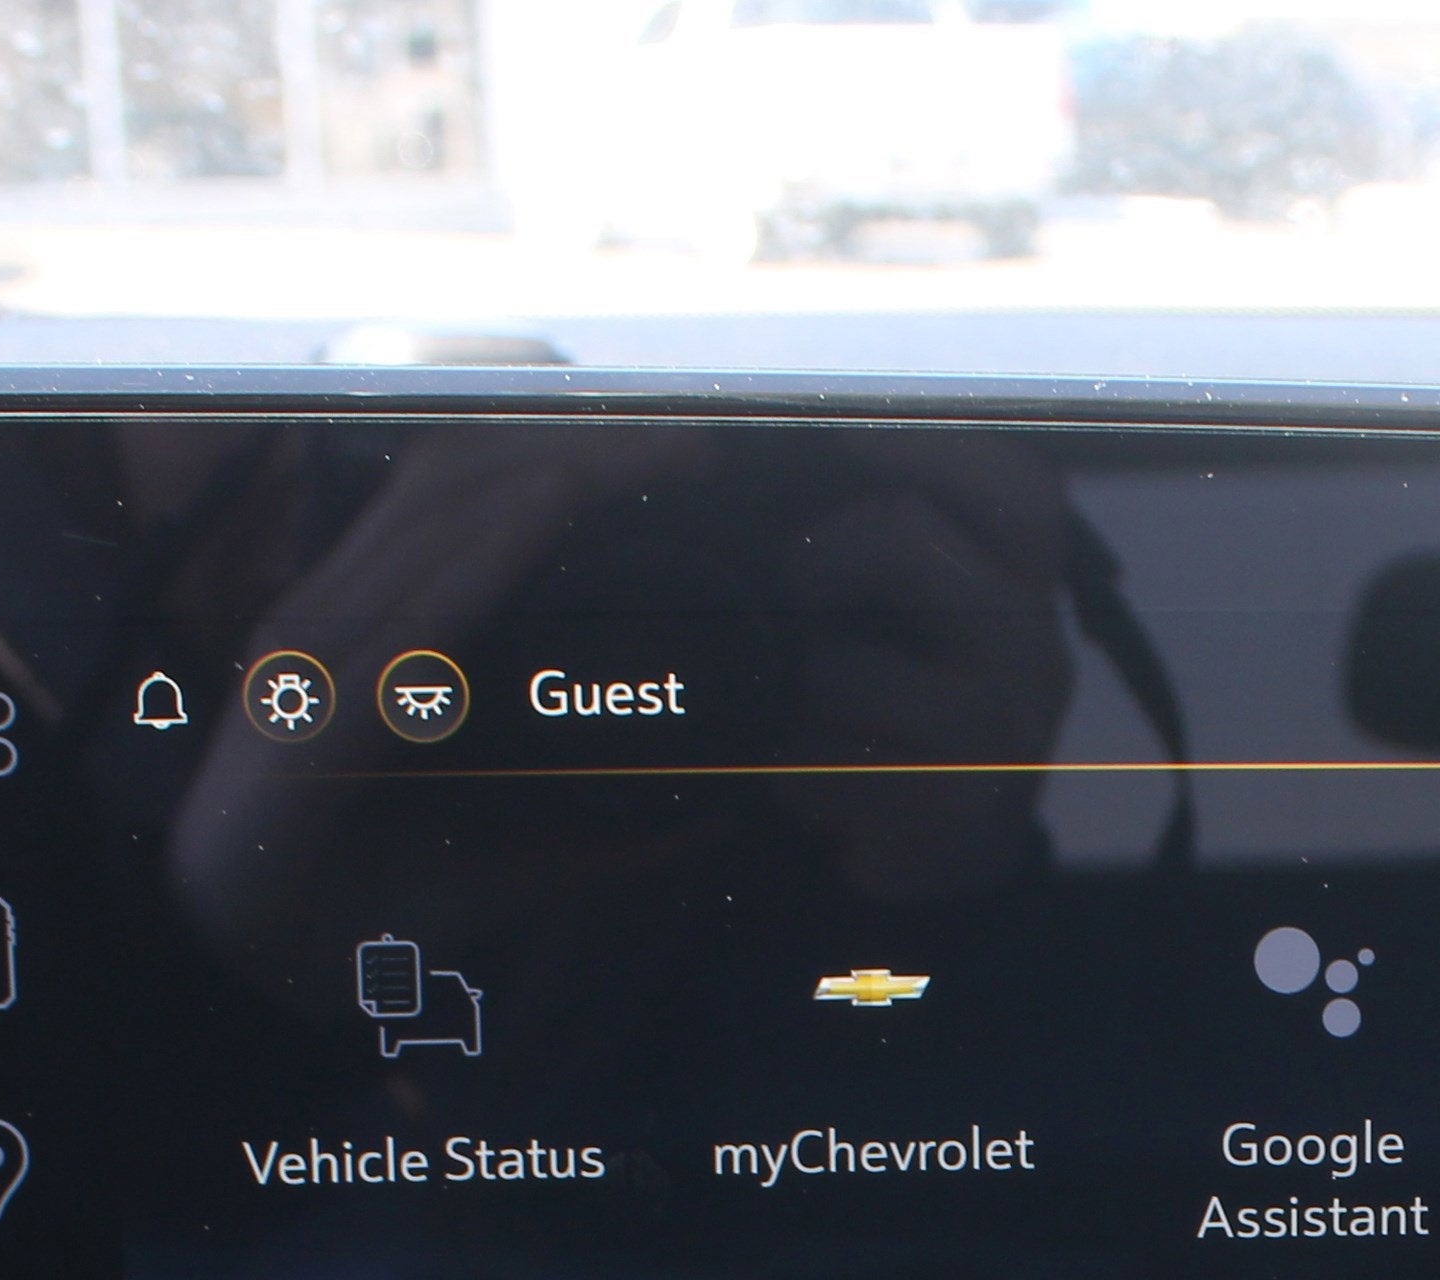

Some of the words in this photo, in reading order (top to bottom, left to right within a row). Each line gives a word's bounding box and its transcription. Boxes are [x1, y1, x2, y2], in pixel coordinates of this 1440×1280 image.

[528, 667, 687, 718] Guest
[242, 1135, 429, 1187] Vehicle
[443, 1135, 607, 1183] Status
[713, 1123, 1036, 1190] myChevrolet
[1221, 1118, 1406, 1180] Google
[1196, 1194, 1430, 1240] Assistant
